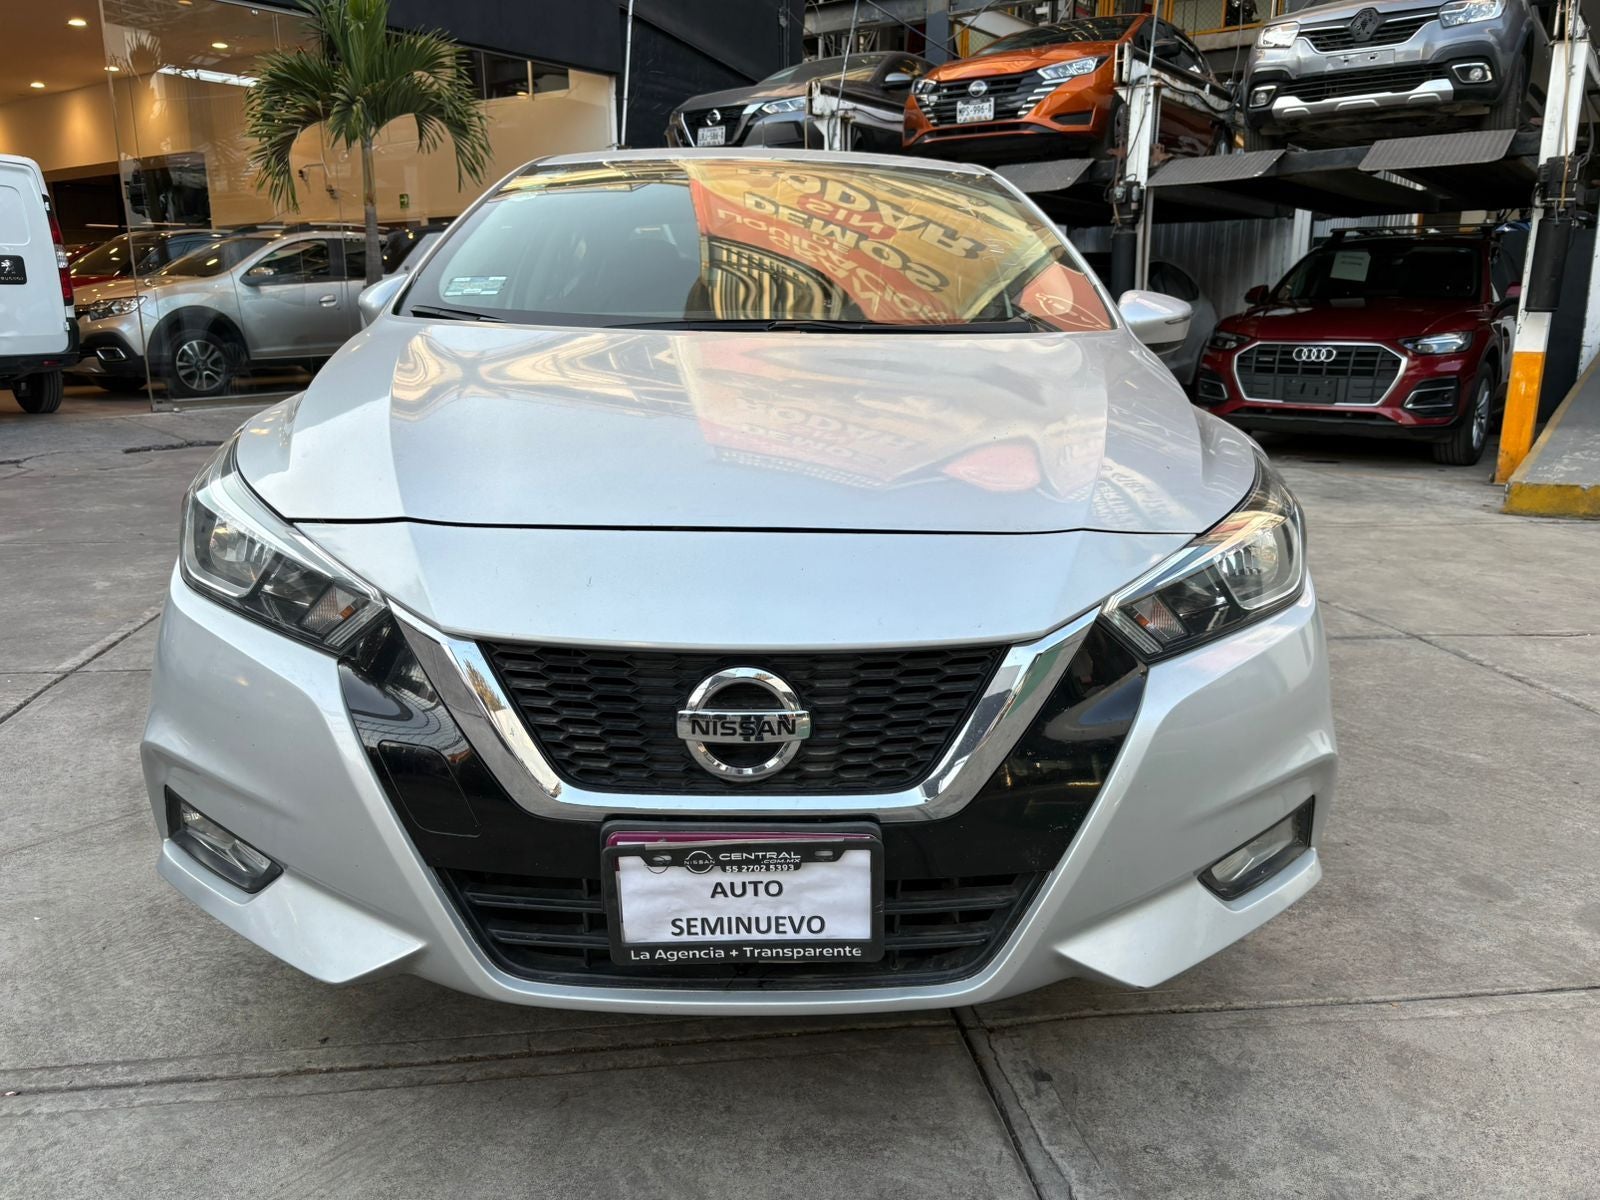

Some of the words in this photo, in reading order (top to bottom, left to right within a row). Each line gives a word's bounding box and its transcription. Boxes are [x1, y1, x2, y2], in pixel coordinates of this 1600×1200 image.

[691, 719, 796, 737] NISSAN
[719, 851, 801, 860] CENTRAL
[725, 865, 738, 873] 55
[741, 864, 766, 872] 2702
[769, 864, 794, 872] 5393
[710, 880, 783, 898] AUTO
[670, 915, 826, 936] SEMINUEVO
[631, 949, 650, 960] La
[654, 947, 725, 962] Agencia
[729, 949, 739, 957] +
[742, 946, 862, 958] Transparente
